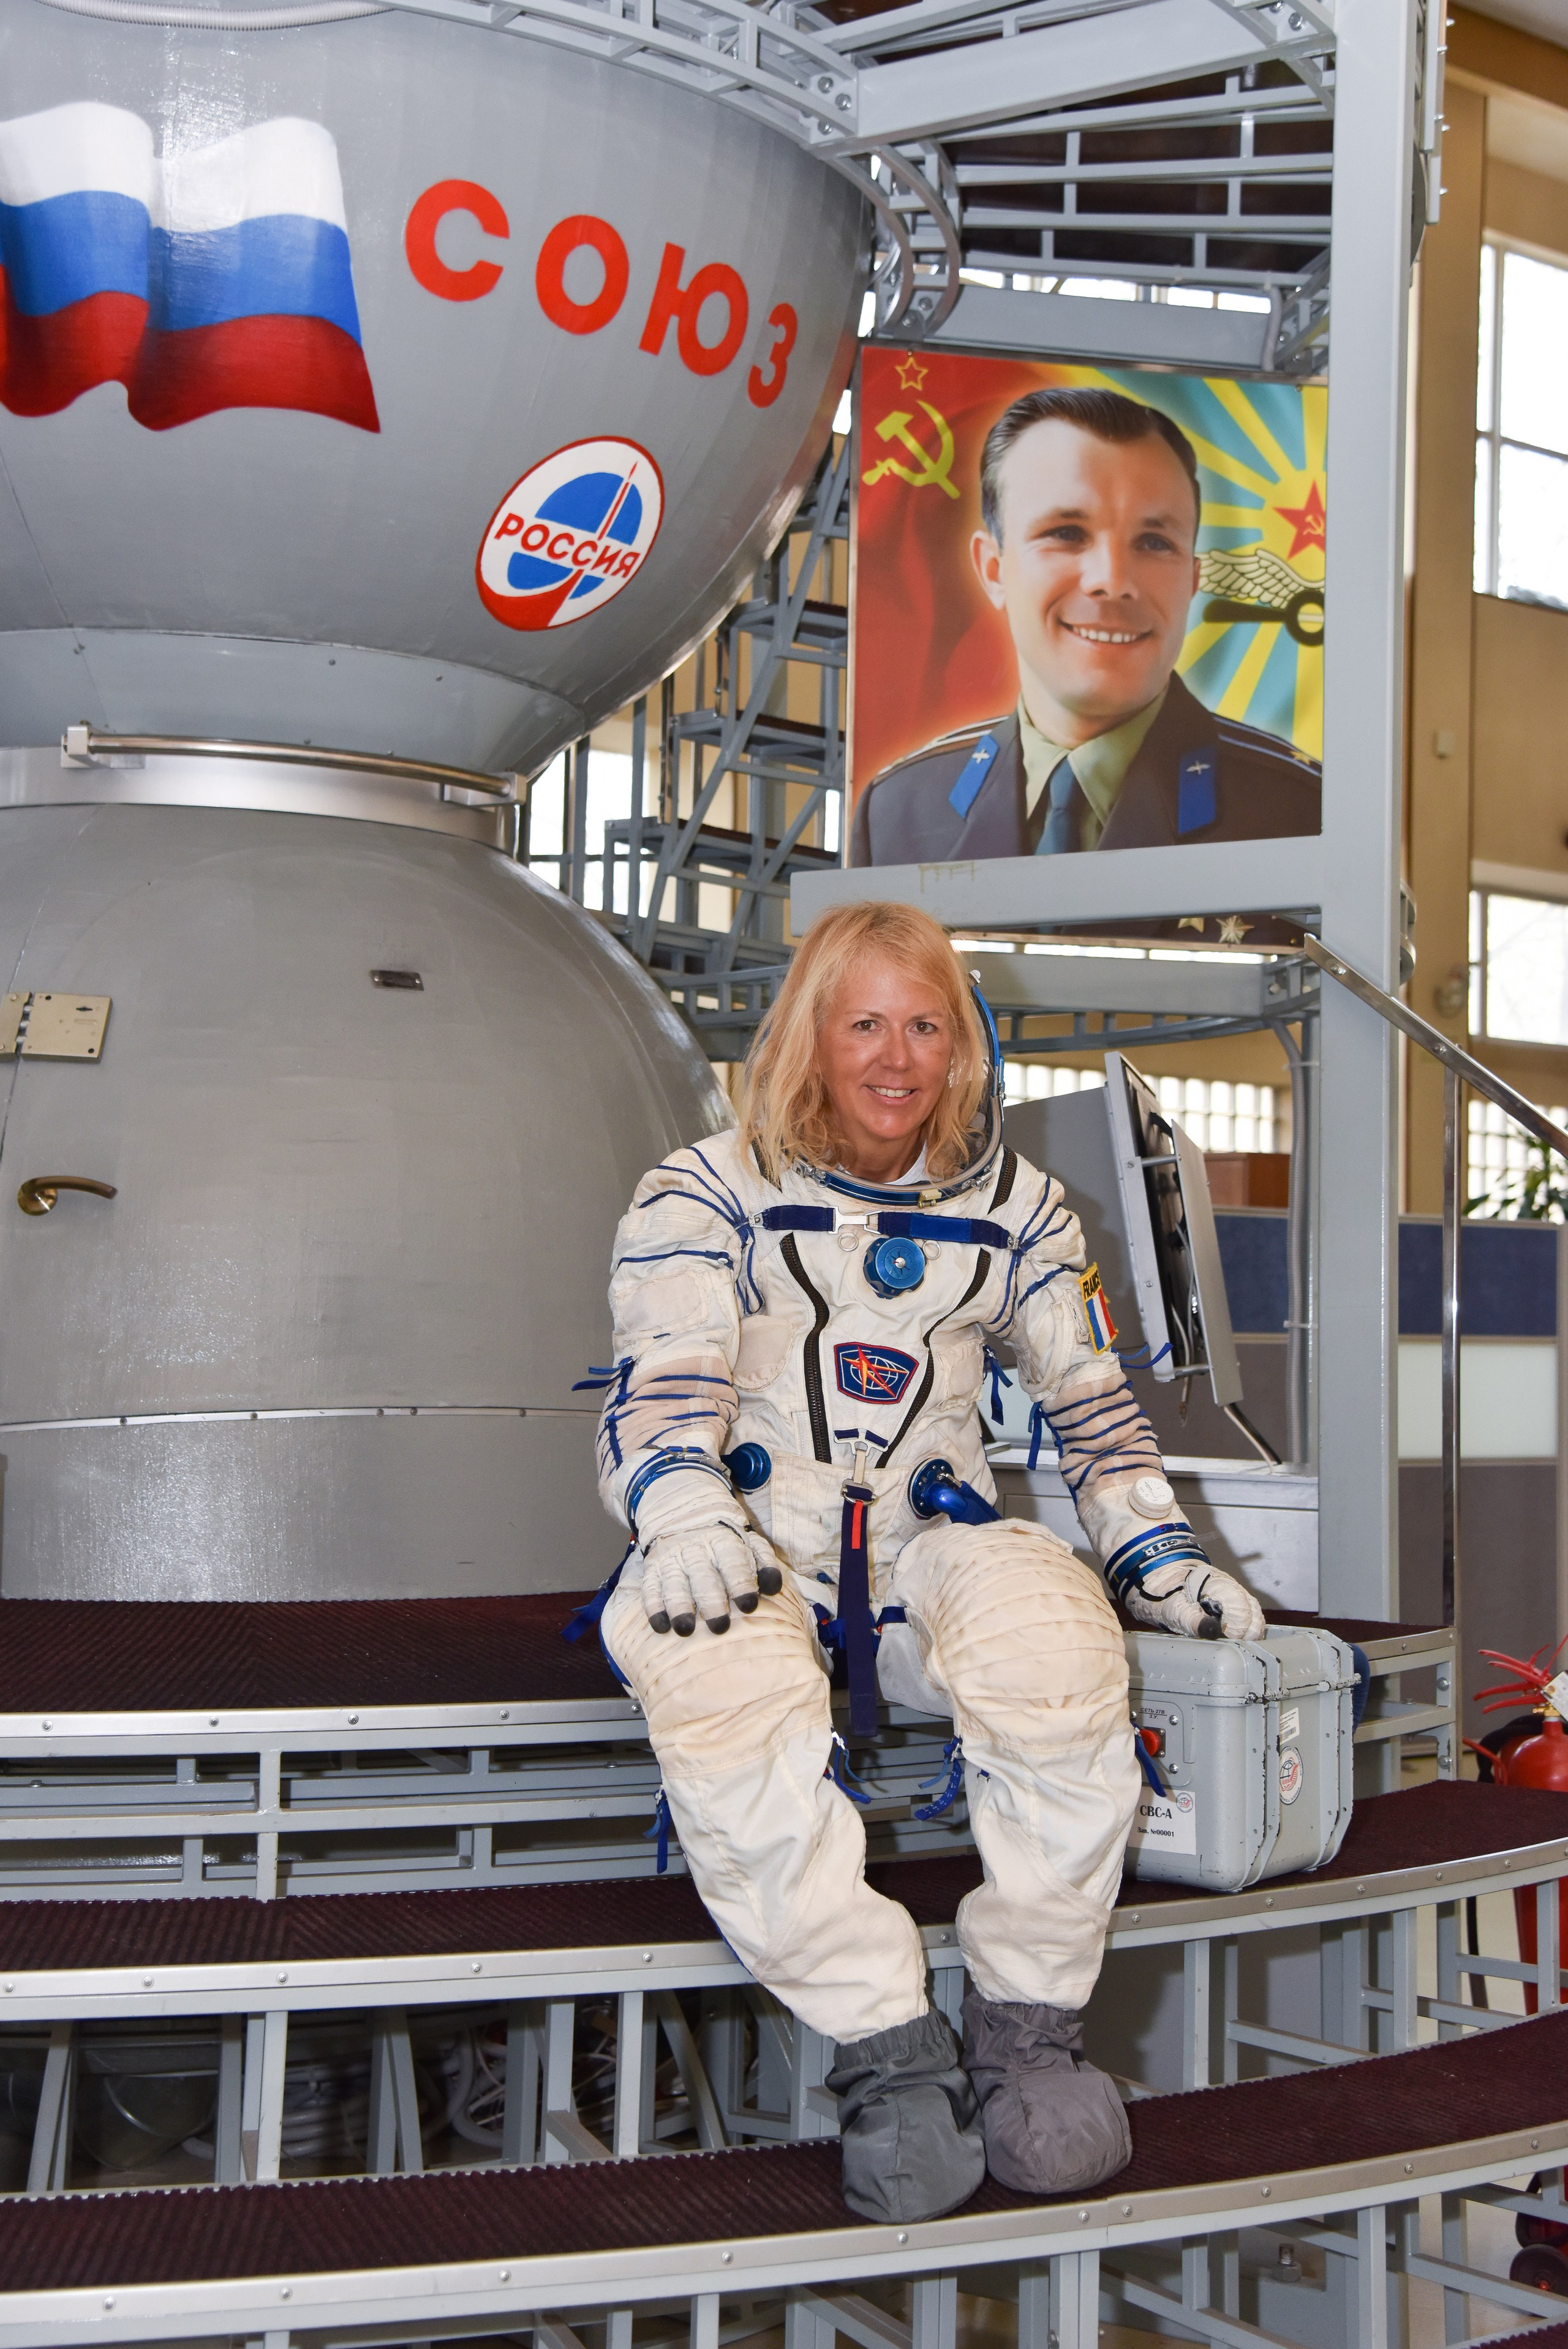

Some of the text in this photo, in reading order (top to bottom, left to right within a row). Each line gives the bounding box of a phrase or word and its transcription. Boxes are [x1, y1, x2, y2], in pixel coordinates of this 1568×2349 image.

[405, 179, 798, 408] СОЮЗ
[494, 513, 641, 578] РОССИЯ
[1082, 1269, 1101, 1300] FRANCE
[1139, 1804, 1172, 1819] СВС-А
